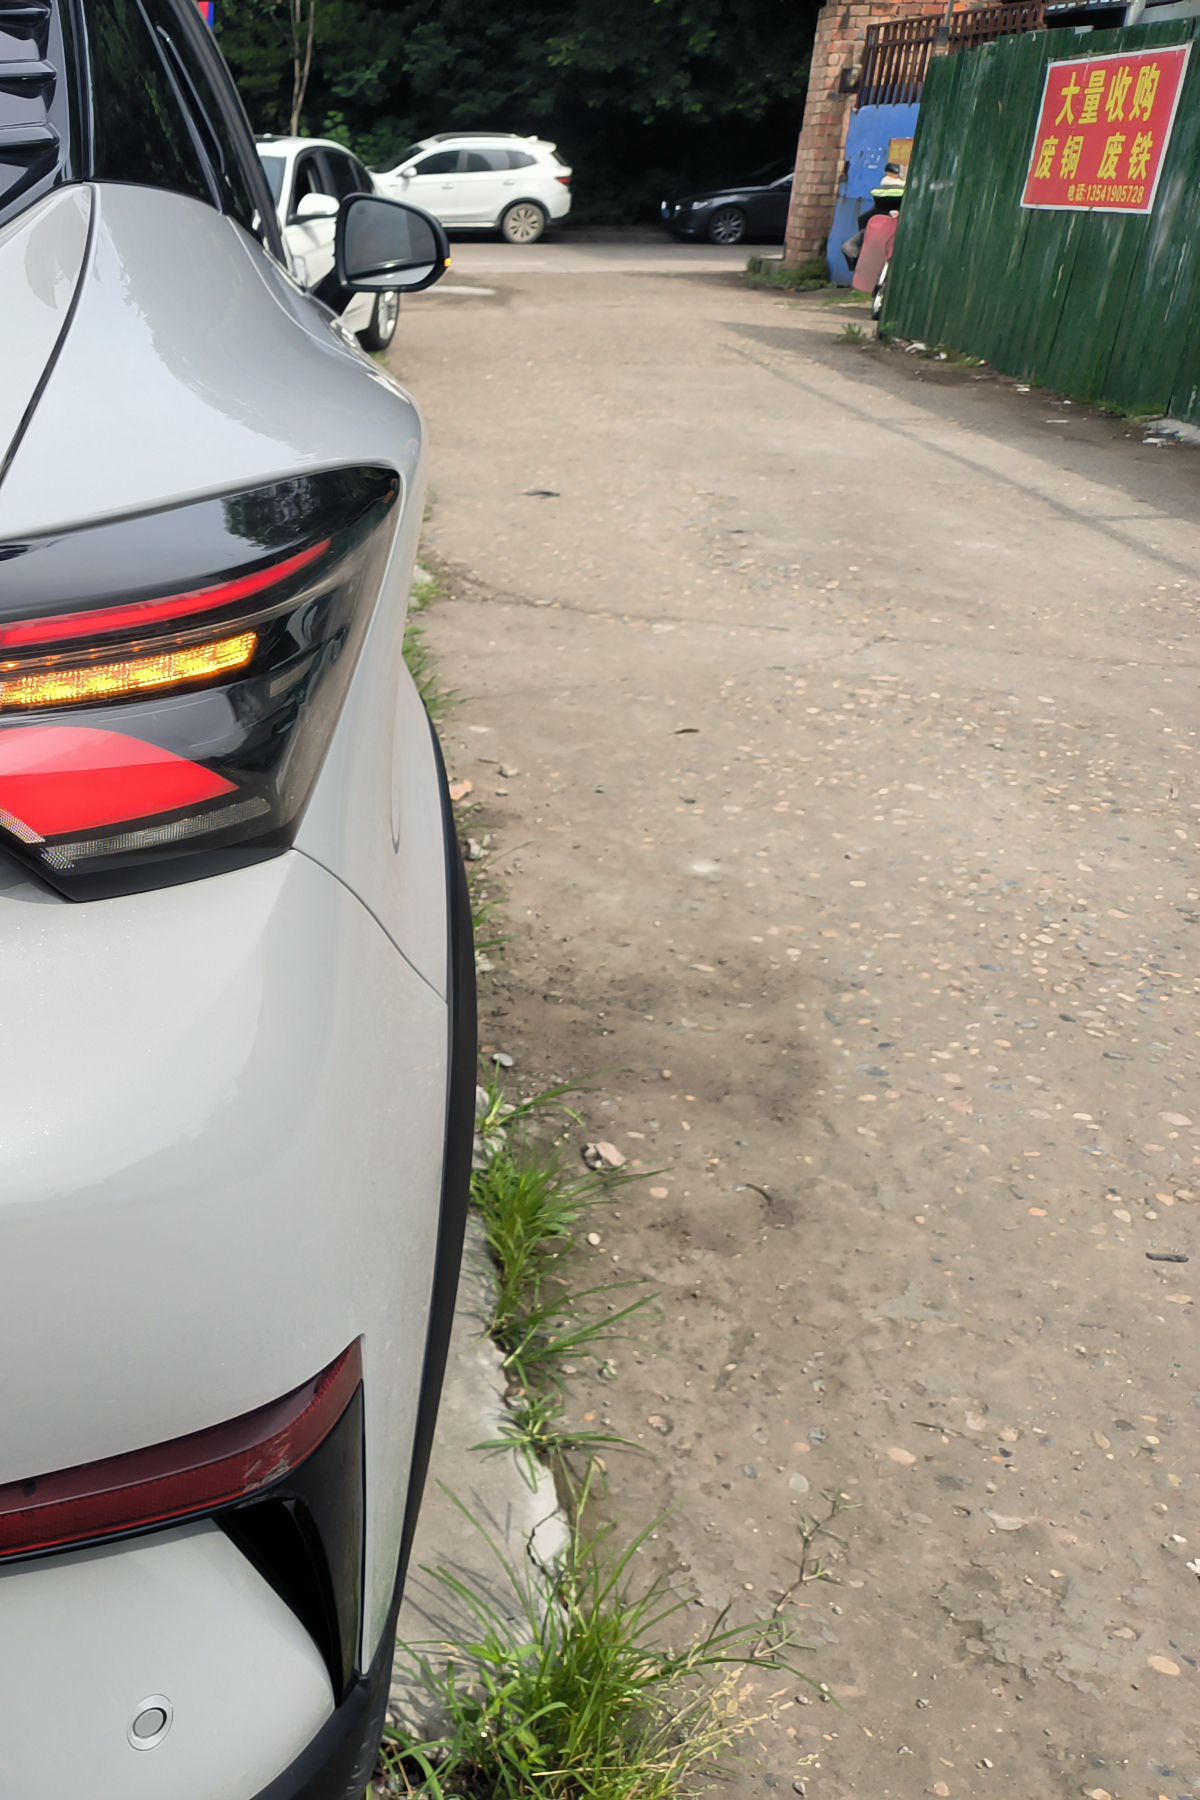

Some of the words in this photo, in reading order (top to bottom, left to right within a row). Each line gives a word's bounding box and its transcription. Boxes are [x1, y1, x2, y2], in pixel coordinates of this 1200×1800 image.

[1055, 62, 1161, 126] 大量收购
[1034, 135, 1085, 180] 废铜
[1096, 131, 1153, 180] 废铁
